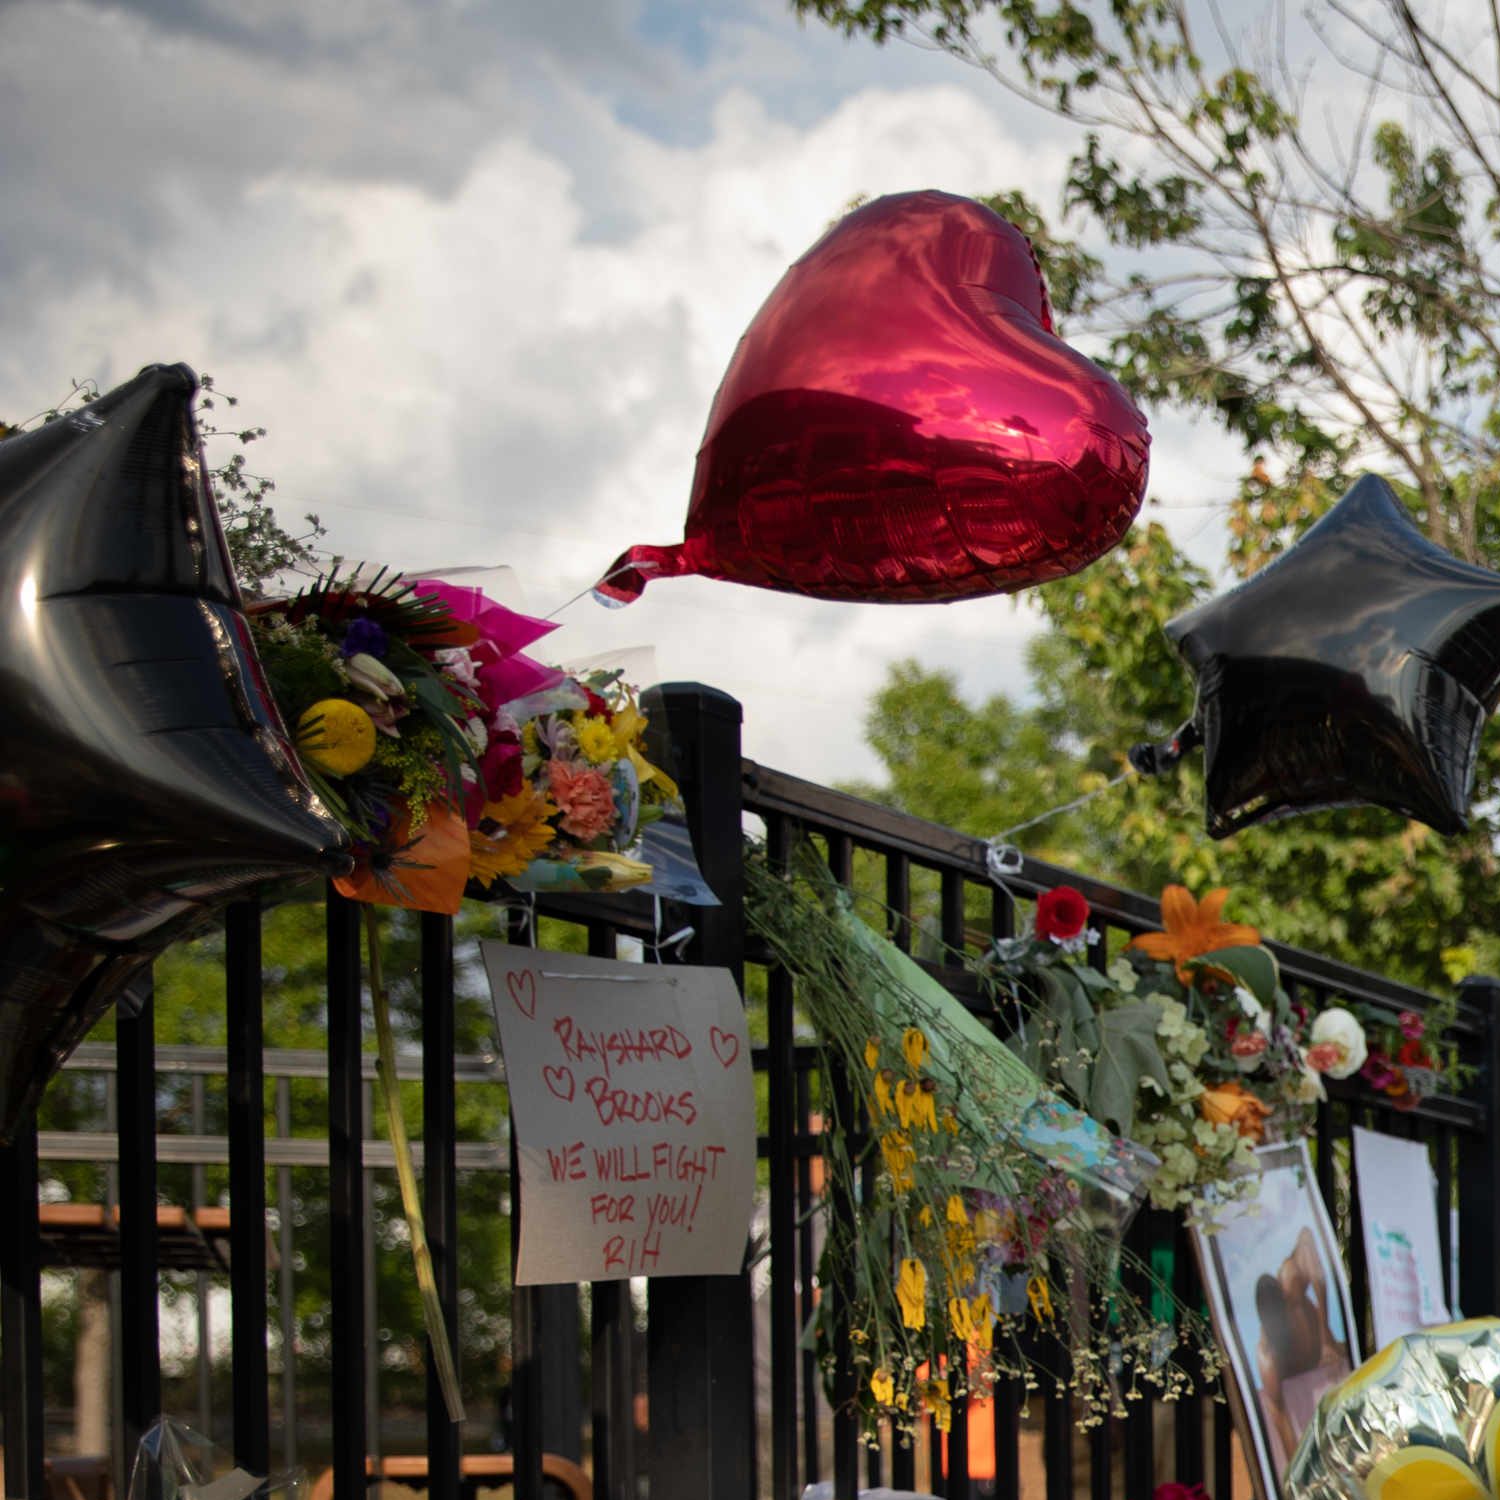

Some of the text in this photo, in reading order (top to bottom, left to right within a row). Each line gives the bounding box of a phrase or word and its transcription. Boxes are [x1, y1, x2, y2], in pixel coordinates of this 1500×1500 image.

[554, 1016, 692, 1079] RAYSHARD
[585, 1076, 697, 1126] BROOKS
[547, 1142, 726, 1182] WE WILL FIGHT
[591, 1193, 635, 1224] FOR
